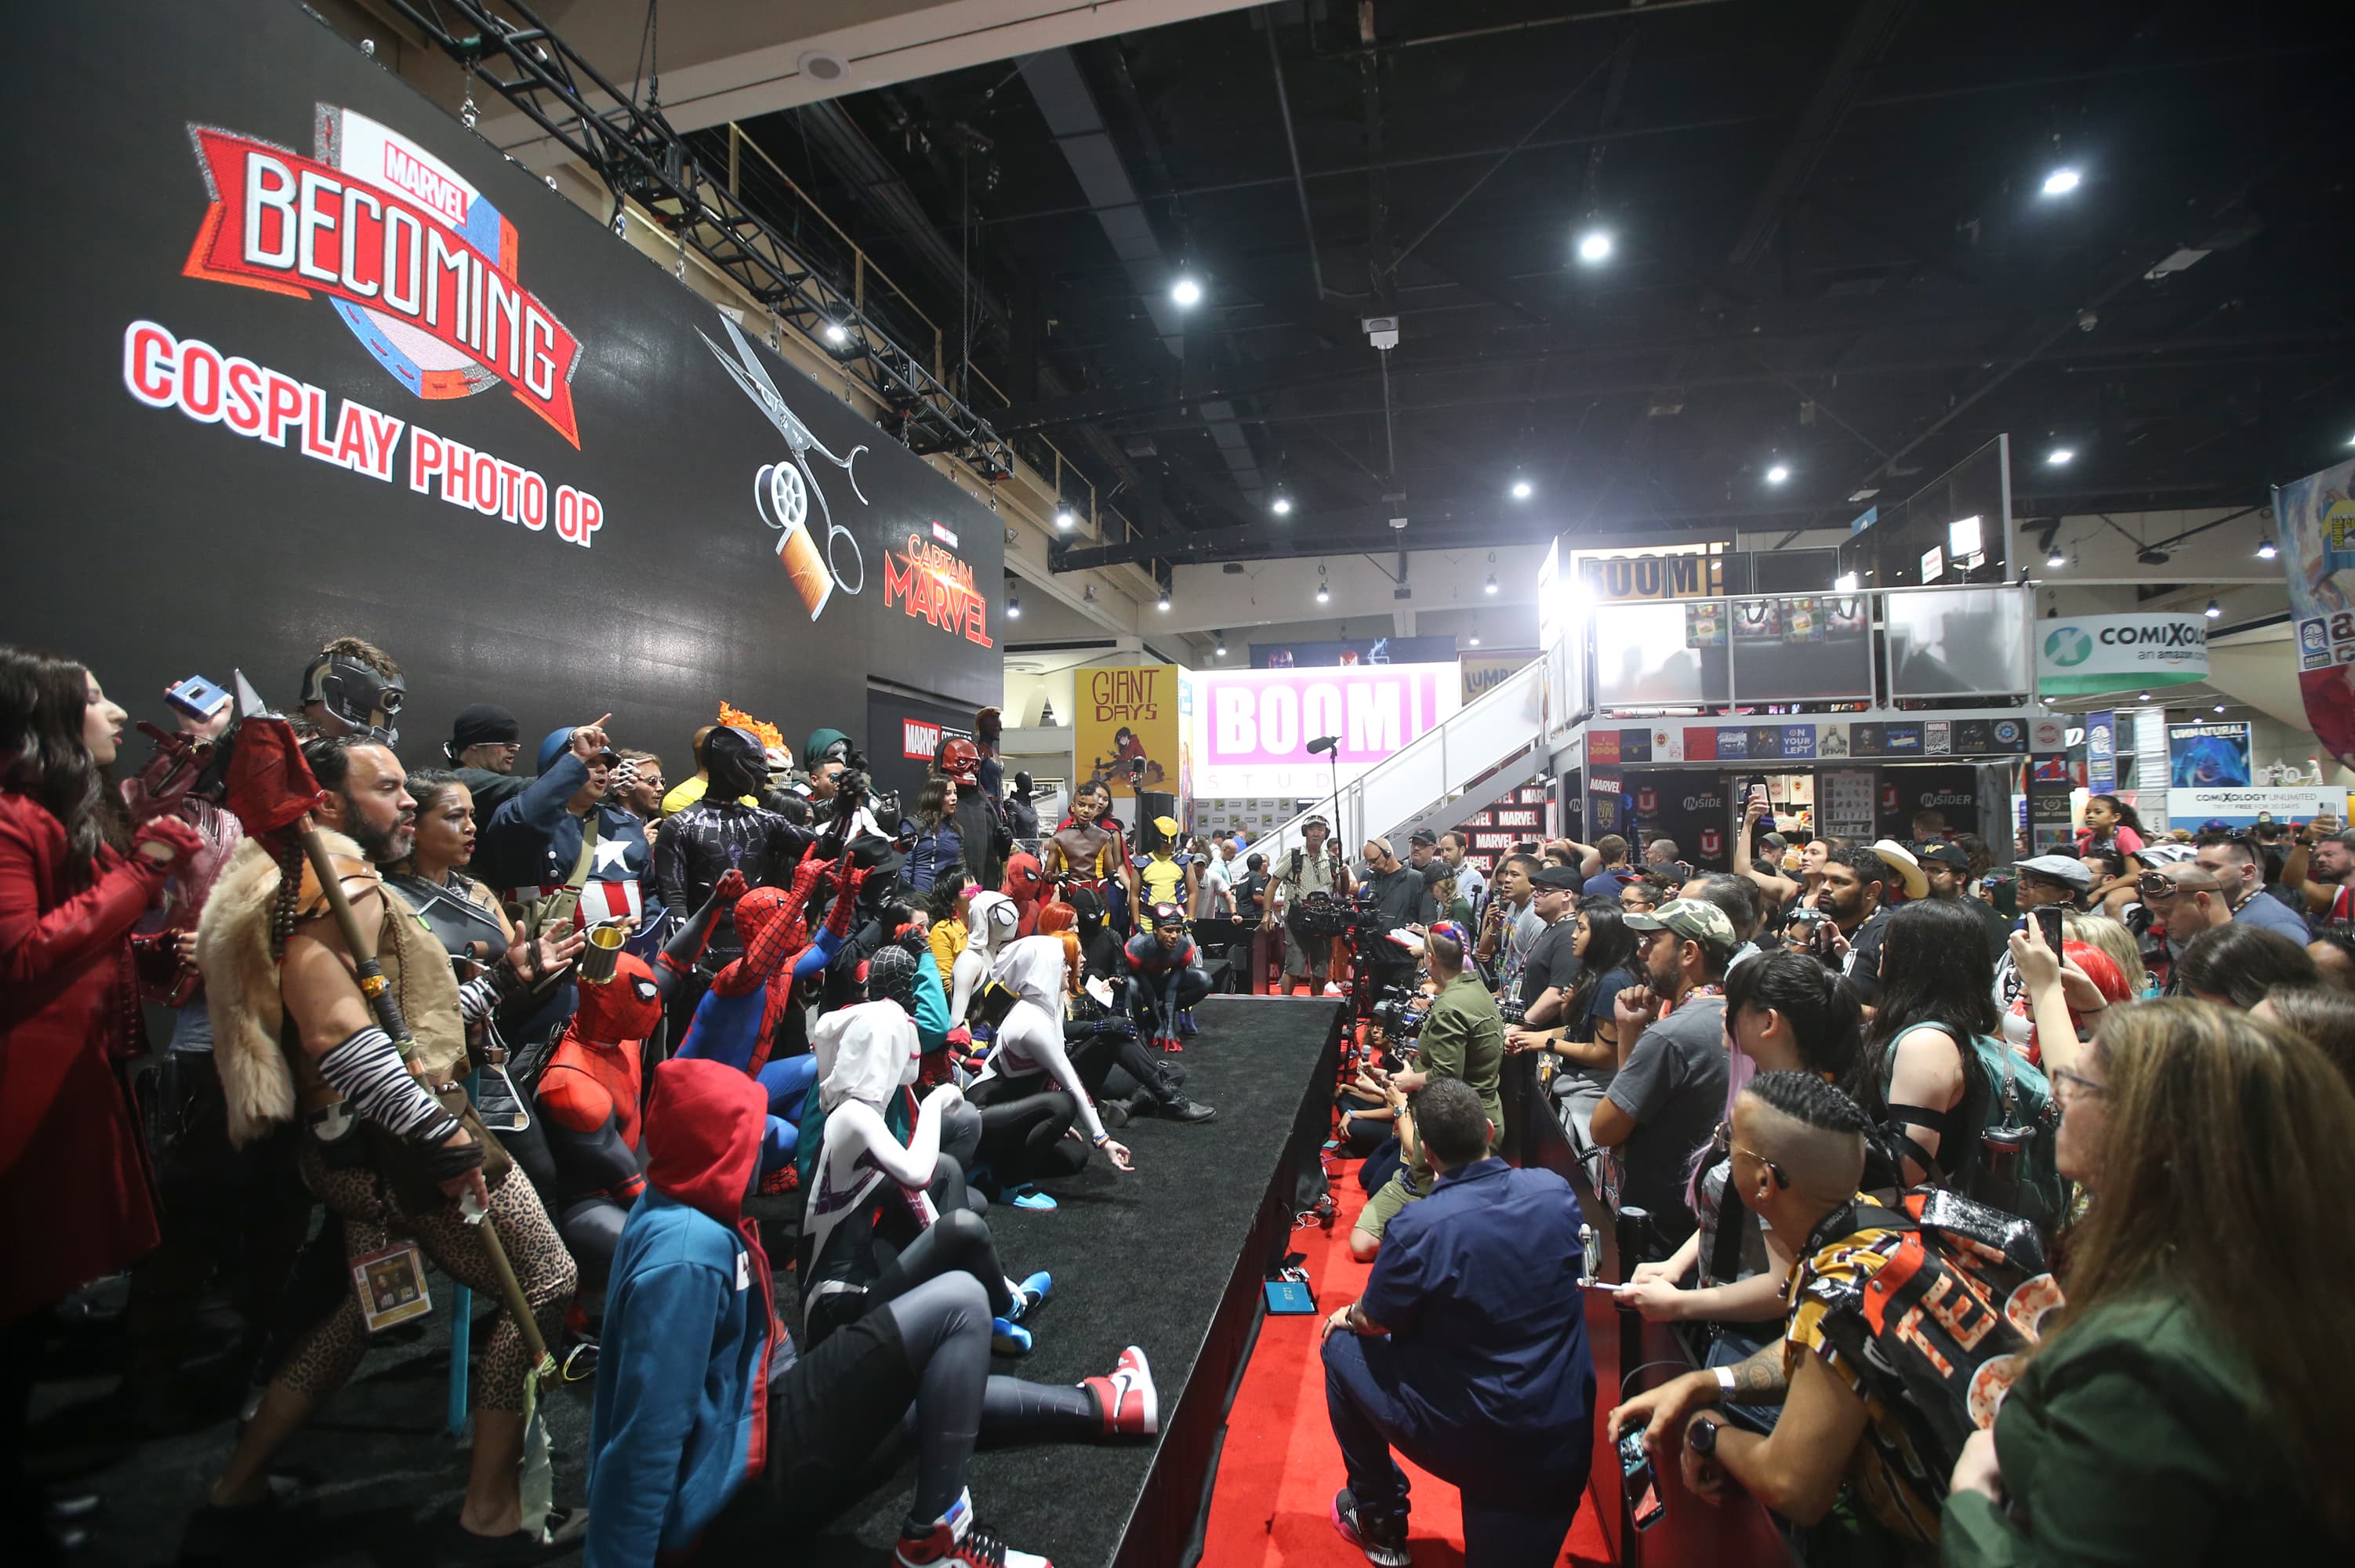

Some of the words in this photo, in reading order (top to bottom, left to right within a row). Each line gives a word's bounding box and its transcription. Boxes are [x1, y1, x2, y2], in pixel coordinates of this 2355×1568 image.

[386, 143, 467, 224] MARVEL
[244, 151, 557, 401] BECOMING
[124, 319, 405, 482] COSPLAY
[410, 424, 548, 531] PHOTO
[555, 485, 604, 548] OP
[908, 533, 973, 593] CAPTAIN
[884, 549, 993, 648] MARVEL
[2138, 652, 2154, 660] an
[1092, 669, 1160, 706] GIANT
[1096, 704, 1158, 722] DAYS
[905, 722, 939, 757] MARVEL
[1783, 737, 1811, 746] YOUR
[1590, 746, 1620, 755] 3000
[1784, 746, 1809, 754] LEFT
[1589, 778, 1620, 794] MARVEL
[1921, 792, 1973, 808] INSIDER
[1499, 811, 1538, 826] MARVEL
[1475, 833, 1512, 848] MARVEL
